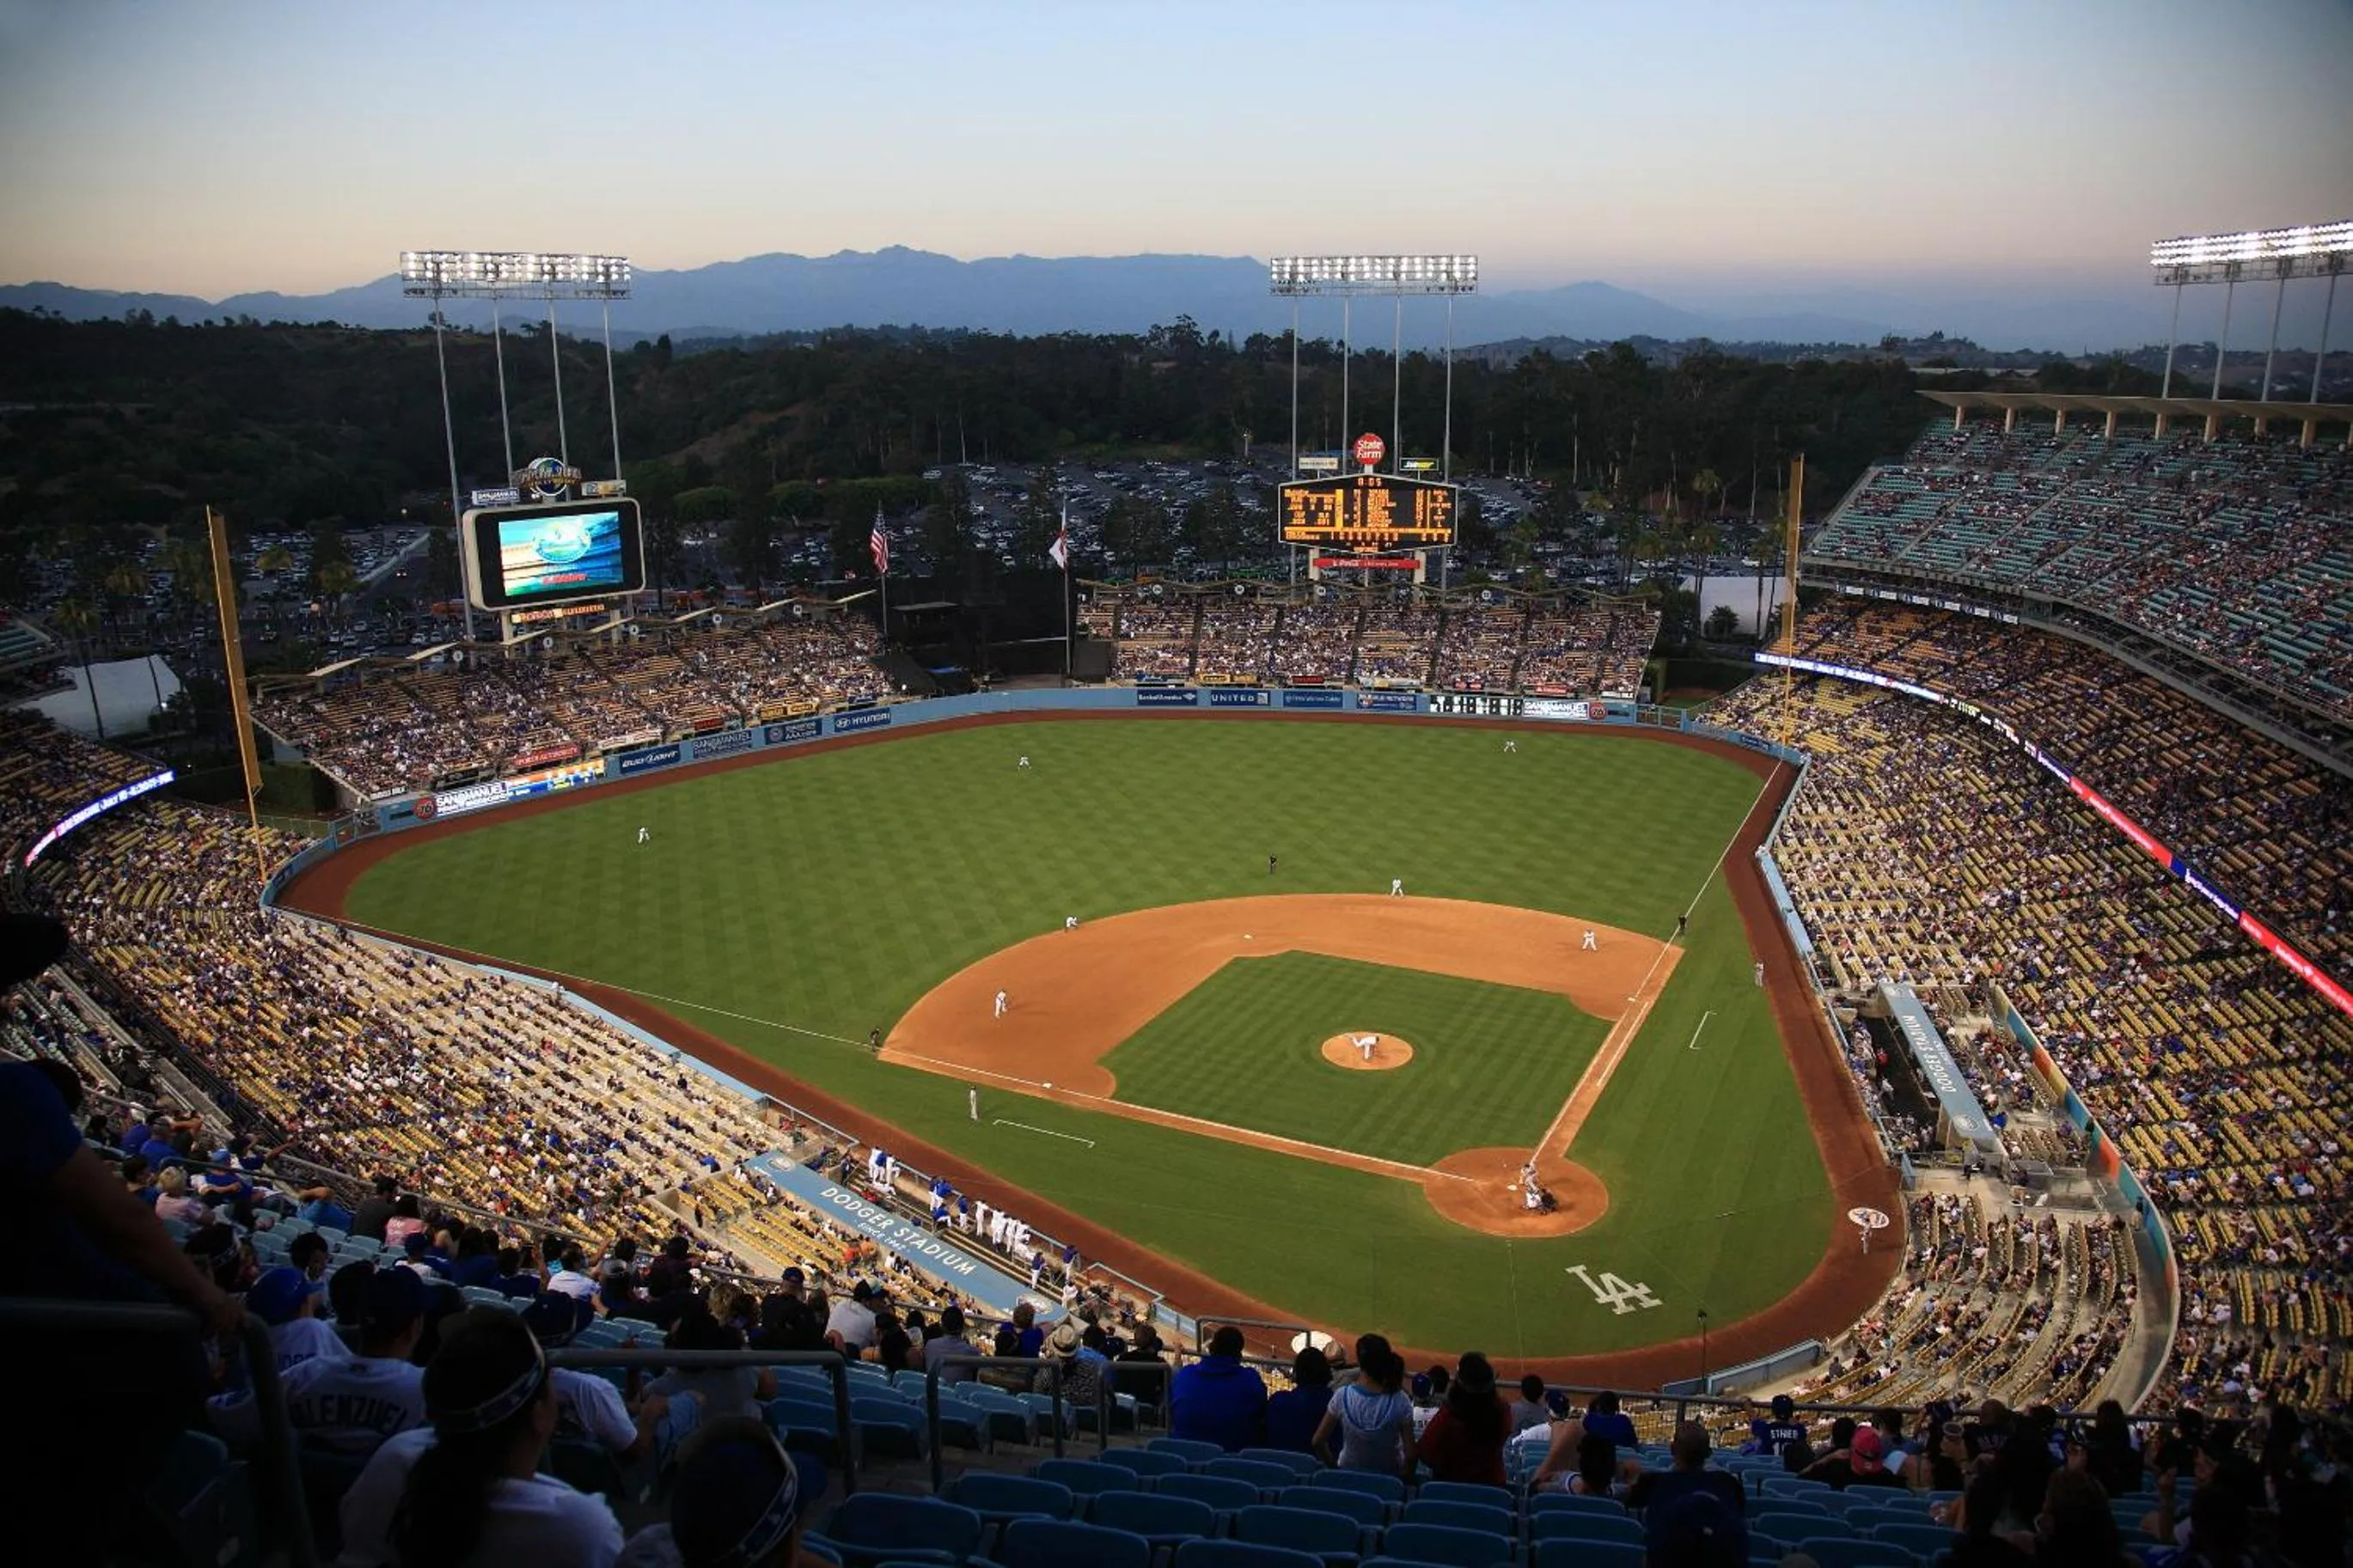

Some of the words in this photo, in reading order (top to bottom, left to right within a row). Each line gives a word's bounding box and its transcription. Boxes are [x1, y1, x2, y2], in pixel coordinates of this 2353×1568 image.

[1358, 439, 1383, 450] State
[1356, 448, 1382, 460] Farm
[852, 711, 891, 726] HYUNDAI
[820, 1187, 895, 1230] DODGER
[894, 1226, 977, 1277] STADIUM
[1565, 1265, 1663, 1315] LA
